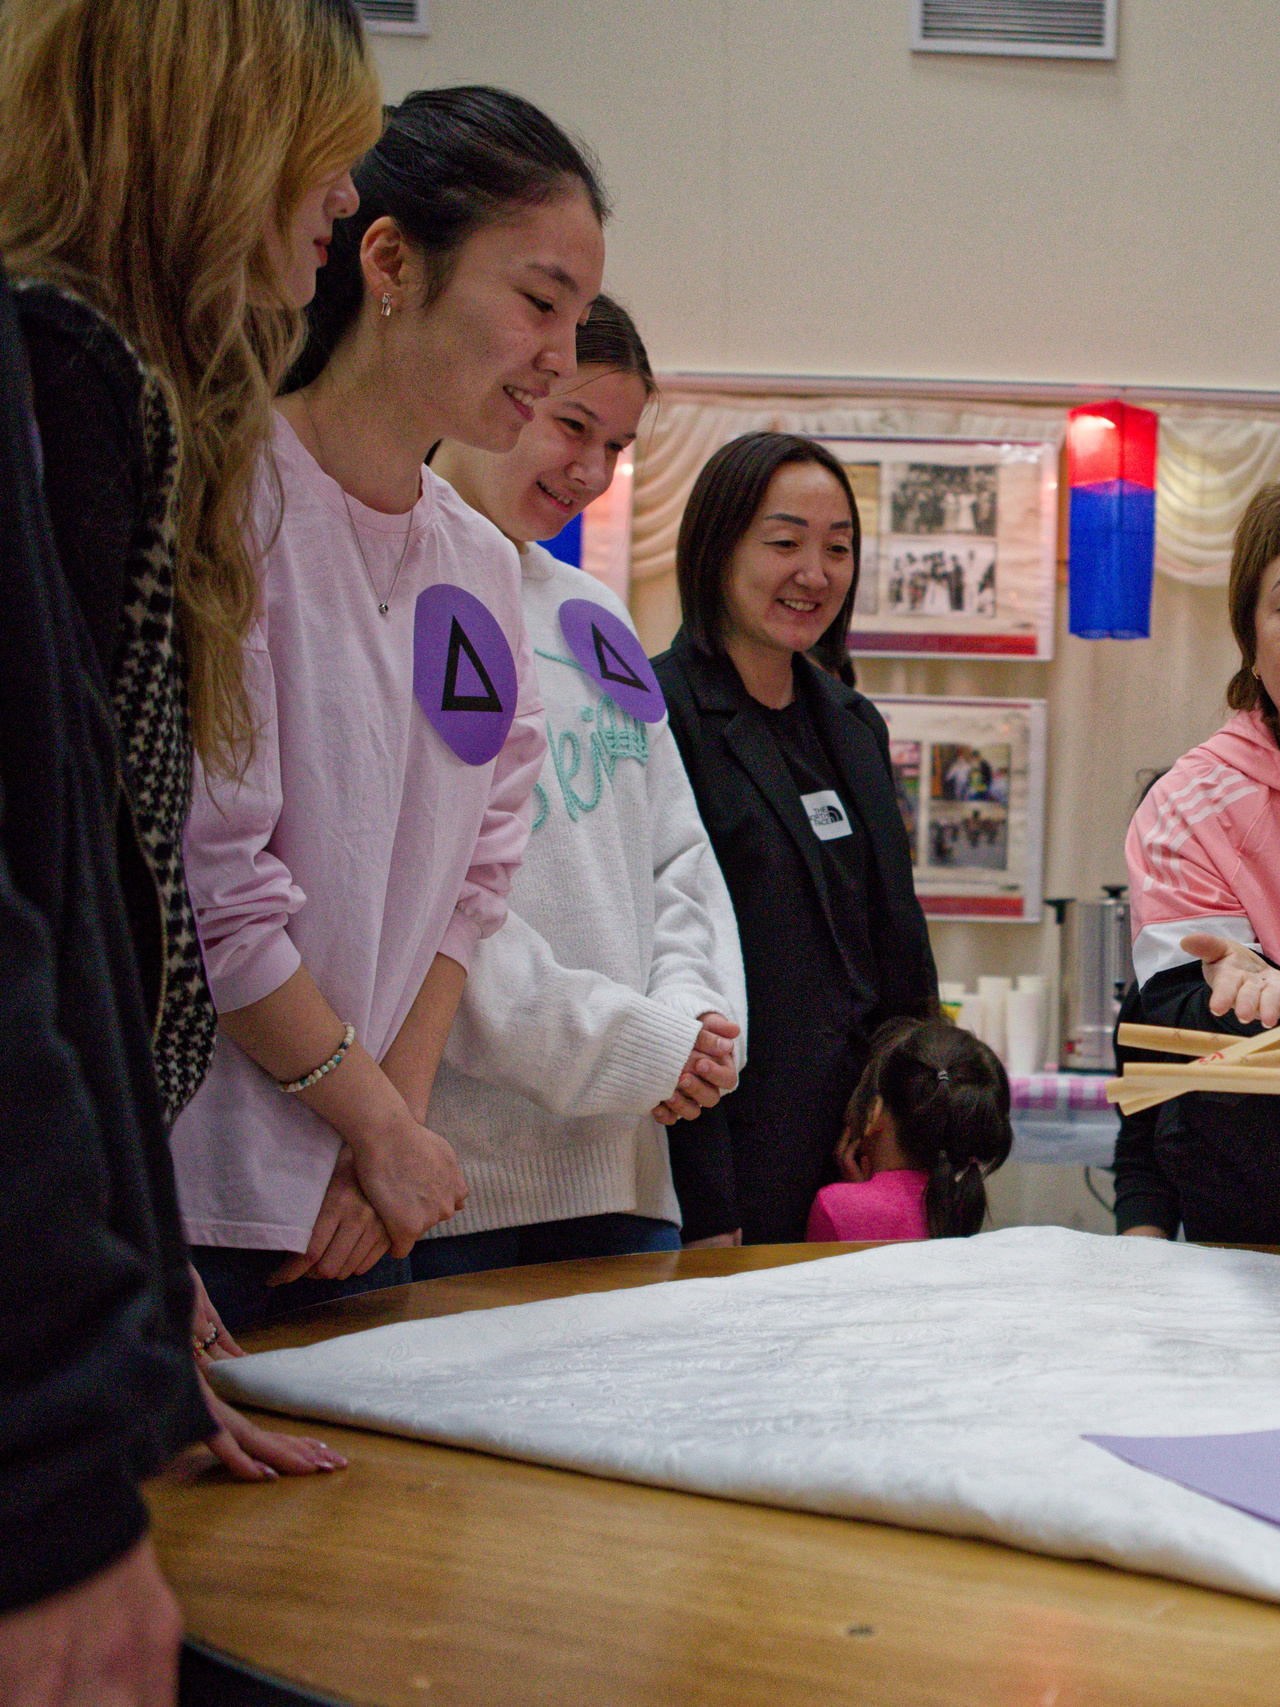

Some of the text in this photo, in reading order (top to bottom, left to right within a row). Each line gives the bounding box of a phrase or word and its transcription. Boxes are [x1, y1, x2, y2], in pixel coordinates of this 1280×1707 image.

[813, 806, 828, 814] THE
[809, 813, 830, 821] ORTH
[814, 818, 831, 826] FACE
